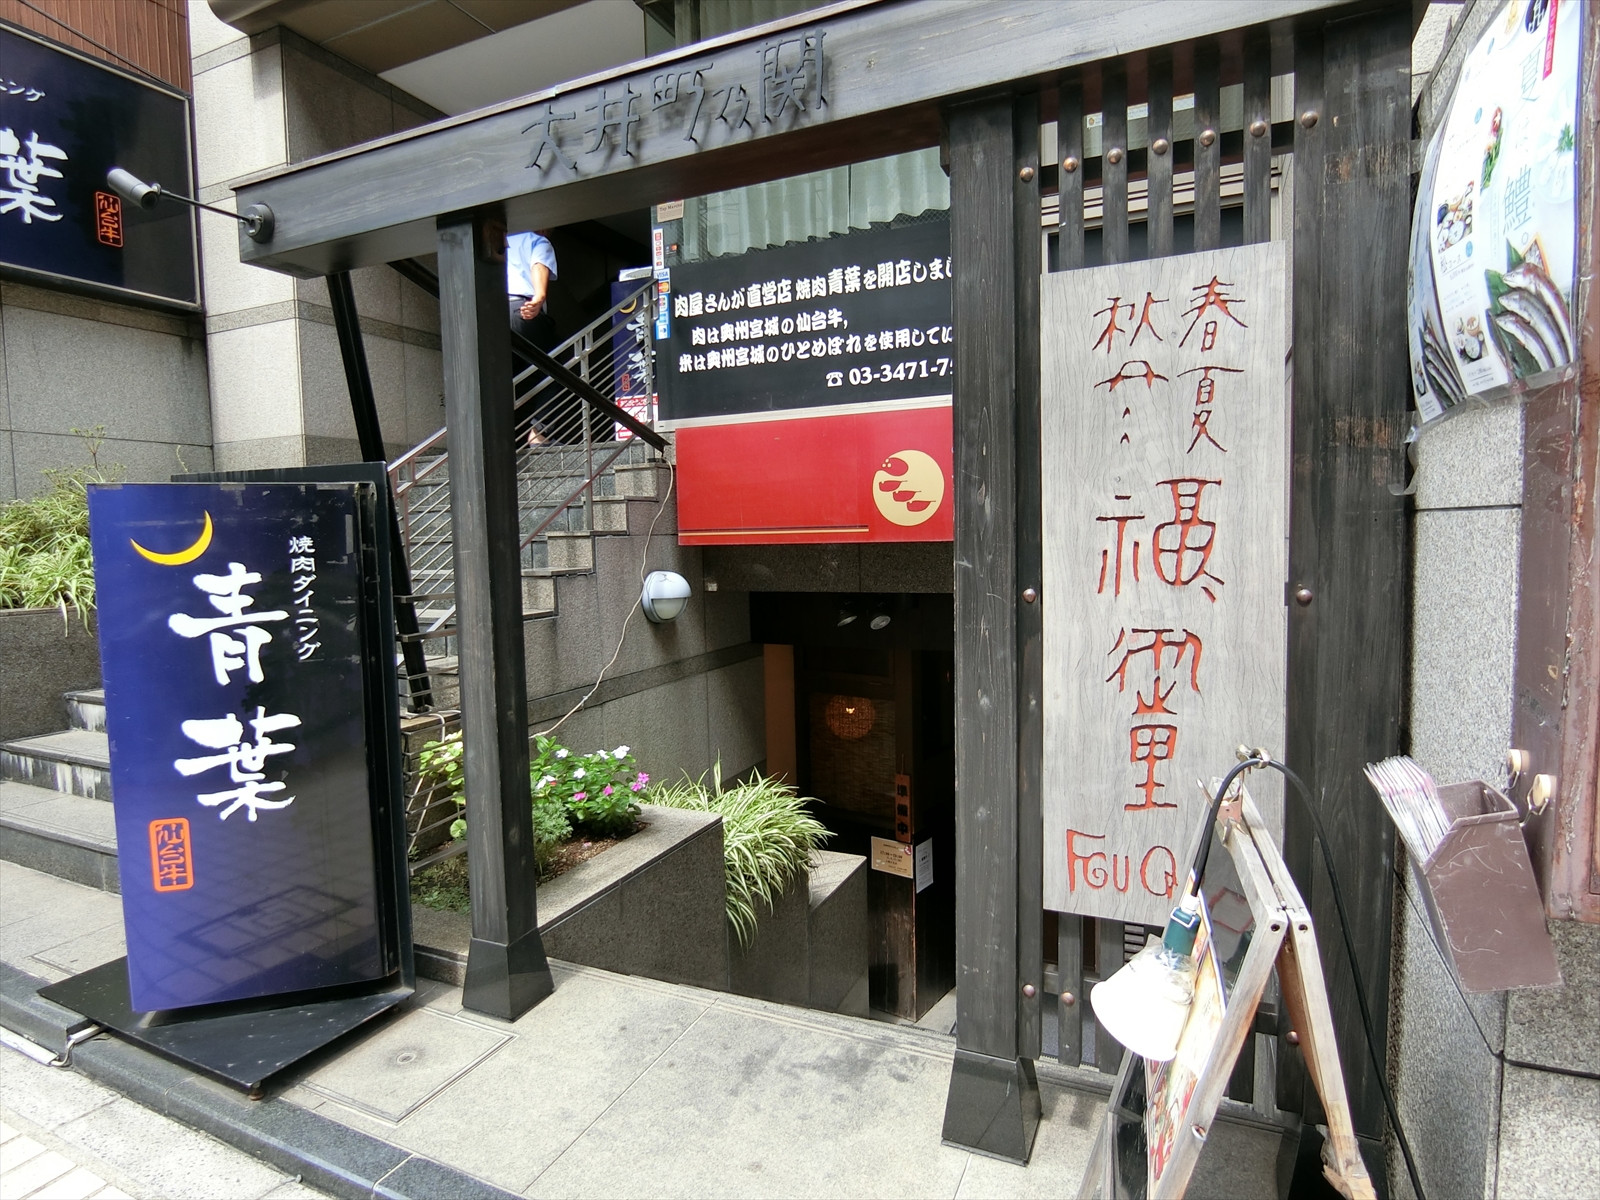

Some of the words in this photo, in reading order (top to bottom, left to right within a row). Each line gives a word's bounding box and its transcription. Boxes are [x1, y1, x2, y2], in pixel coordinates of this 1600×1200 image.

[0, 126, 69, 224] 葉
[674, 278, 792, 318] 肉屋さんが直営店
[848, 357, 953, 386] 03-3471-7
[288, 534, 322, 661] 焼肉ダイニング
[167, 561, 302, 823] 青葉
